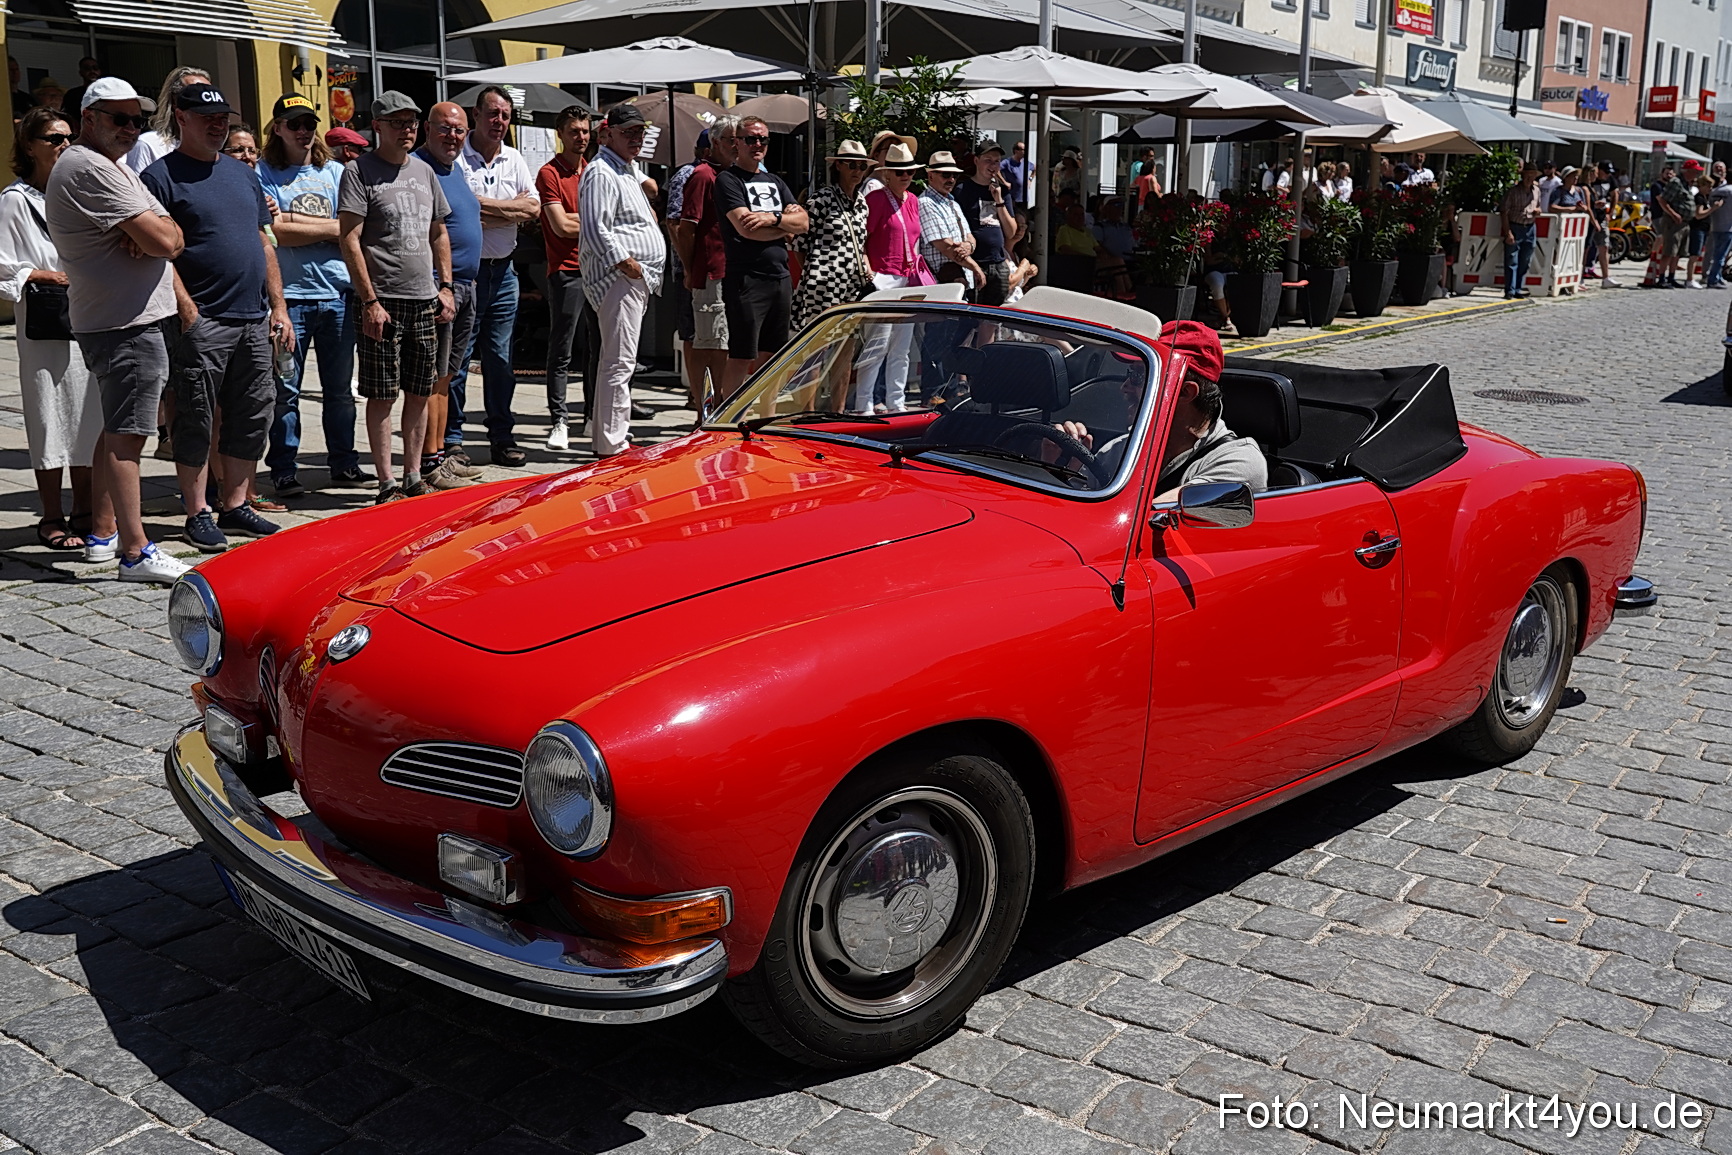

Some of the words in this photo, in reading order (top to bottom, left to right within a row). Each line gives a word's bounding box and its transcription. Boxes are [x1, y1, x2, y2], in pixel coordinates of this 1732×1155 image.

[201, 91, 224, 103] CIA
[1652, 95, 1674, 103] WITT
[298, 926, 369, 995] 141H
[770, 969, 946, 1054] SEMPERIT
